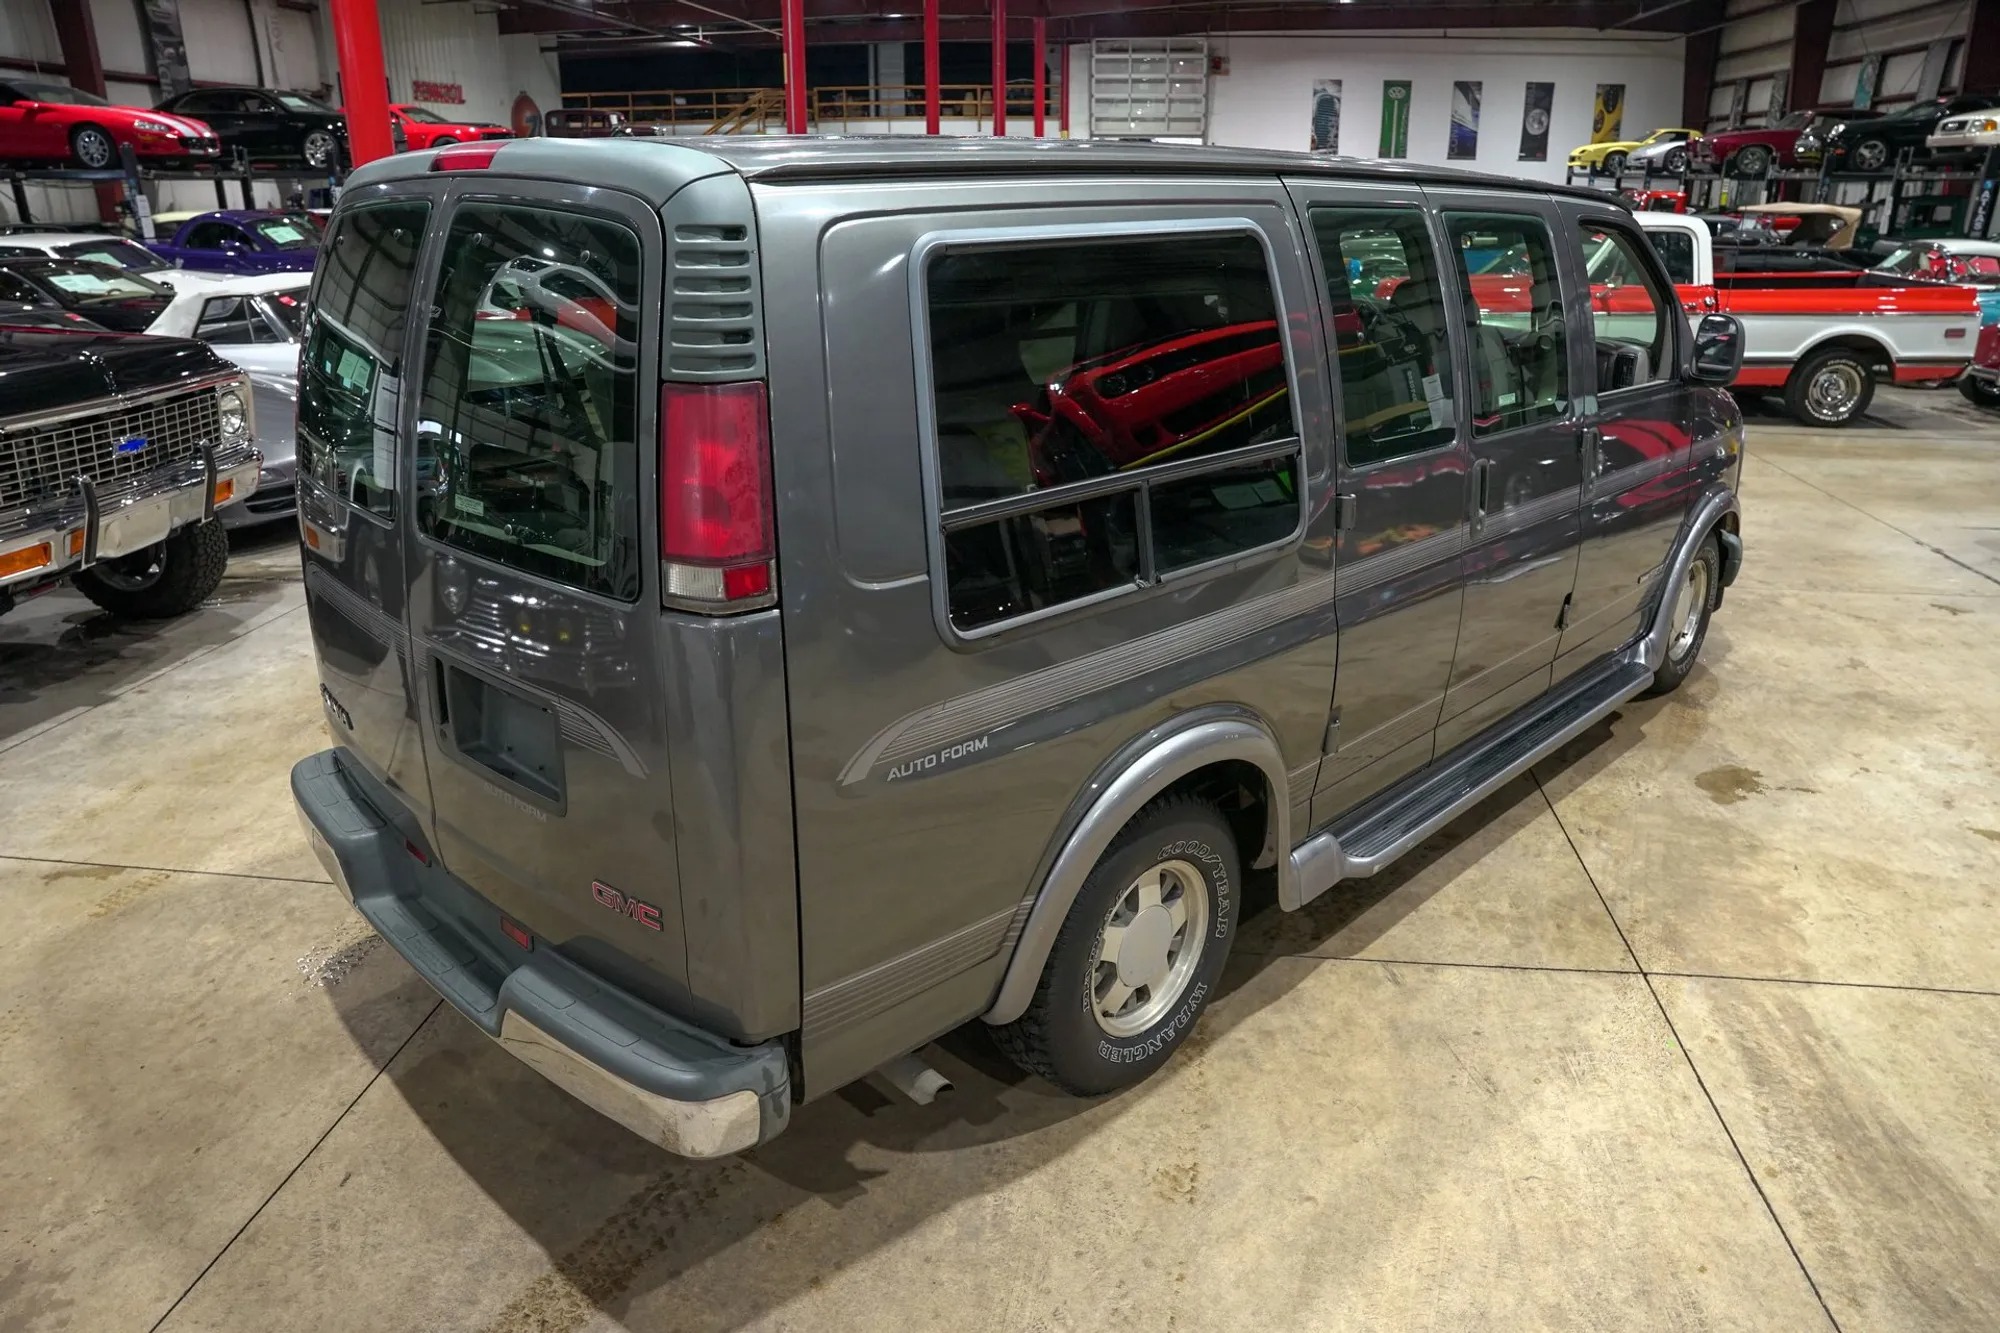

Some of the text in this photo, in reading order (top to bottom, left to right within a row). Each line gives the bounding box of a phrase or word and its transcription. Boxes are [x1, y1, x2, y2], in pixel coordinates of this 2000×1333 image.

[1973, 189, 1991, 231] ATLAS
[887, 736, 988, 781] AUTO FORM
[483, 781, 547, 822] AUTO FORM
[592, 879, 664, 932] GMC
[1098, 982, 1208, 1063] WRANGLER
